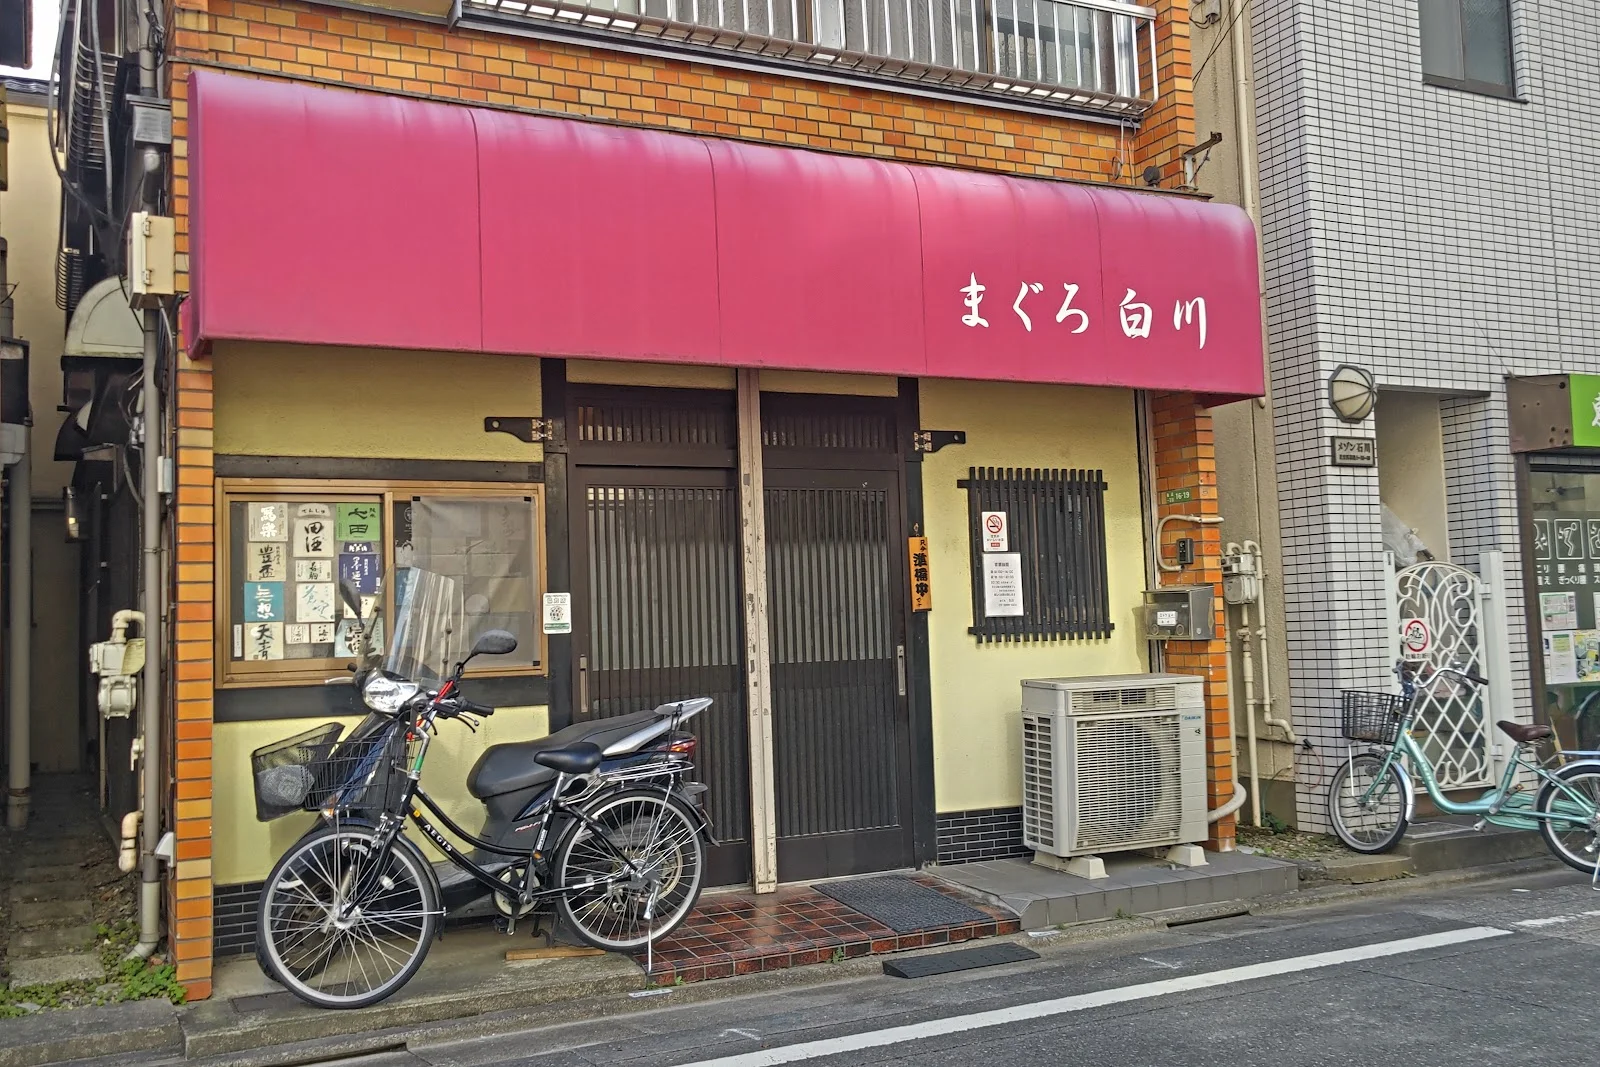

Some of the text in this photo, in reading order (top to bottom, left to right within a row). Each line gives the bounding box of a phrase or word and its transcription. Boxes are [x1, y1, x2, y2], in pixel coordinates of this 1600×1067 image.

[1337, 441, 1371, 453] メゾン石川
[1175, 491, 1190, 500] 16-19
[348, 507, 369, 535] 七田
[304, 521, 325, 553] 田酒
[912, 552, 929, 598] 準備中
[256, 623, 274, 661] 天青
[424, 824, 453, 852] AEGIS
